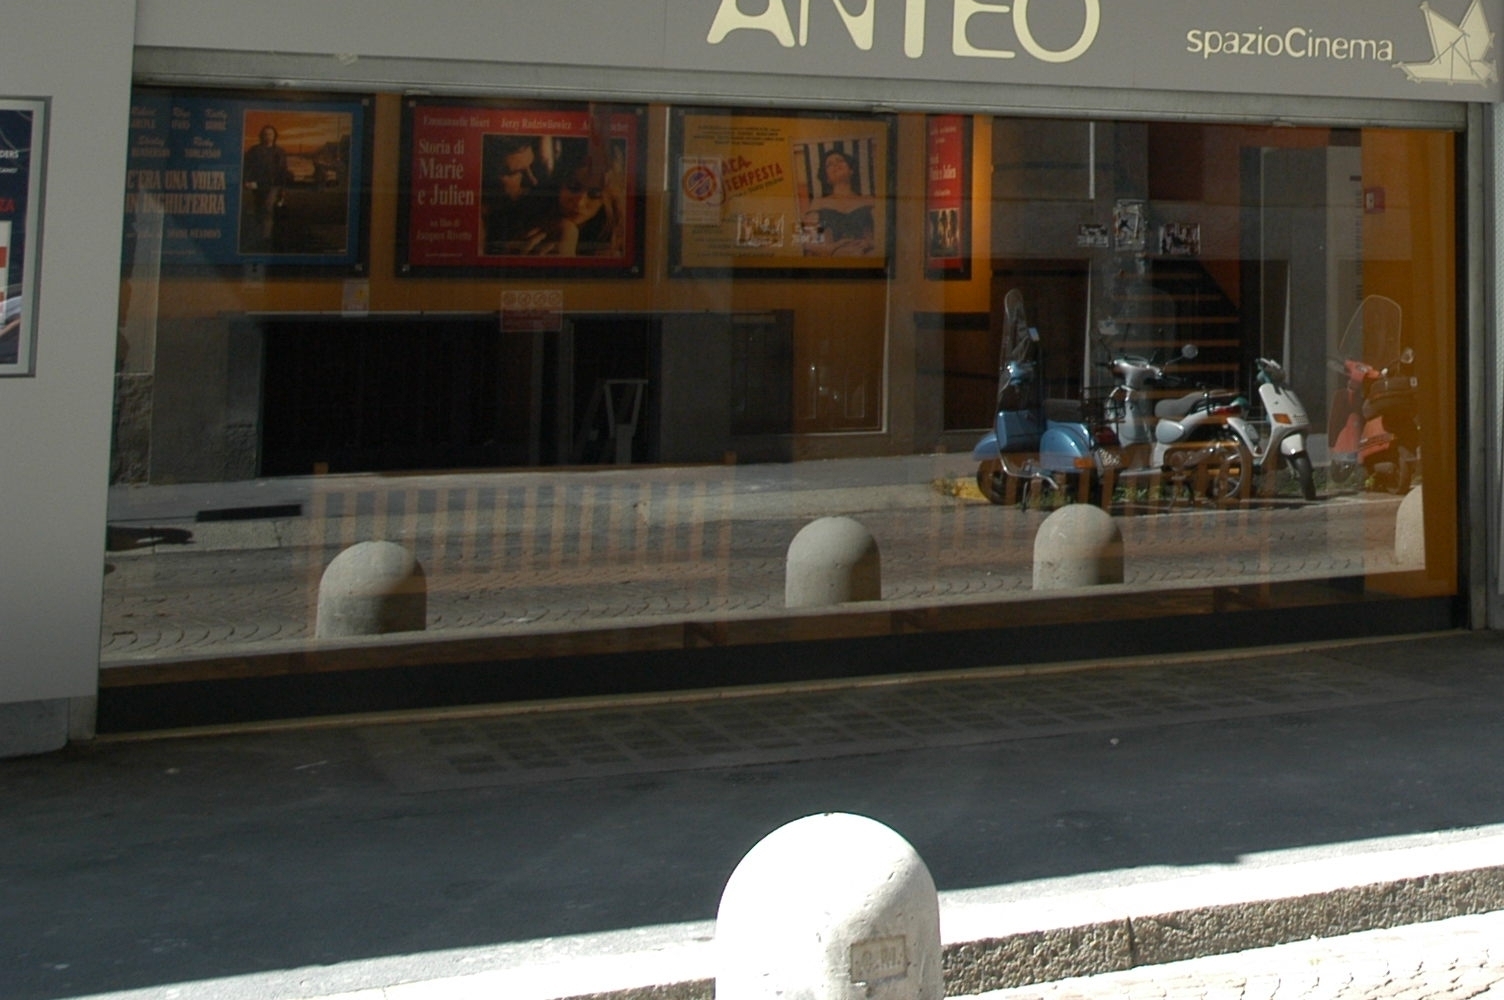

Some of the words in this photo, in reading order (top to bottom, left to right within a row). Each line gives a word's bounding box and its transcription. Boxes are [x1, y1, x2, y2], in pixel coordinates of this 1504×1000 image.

[1185, 25, 1395, 63] spazioCinema
[418, 139, 453, 155] Storia
[453, 139, 465, 155] di
[418, 158, 464, 179] Marie
[164, 169, 188, 190] UNA
[417, 190, 426, 205] e
[429, 184, 475, 206] Julien
